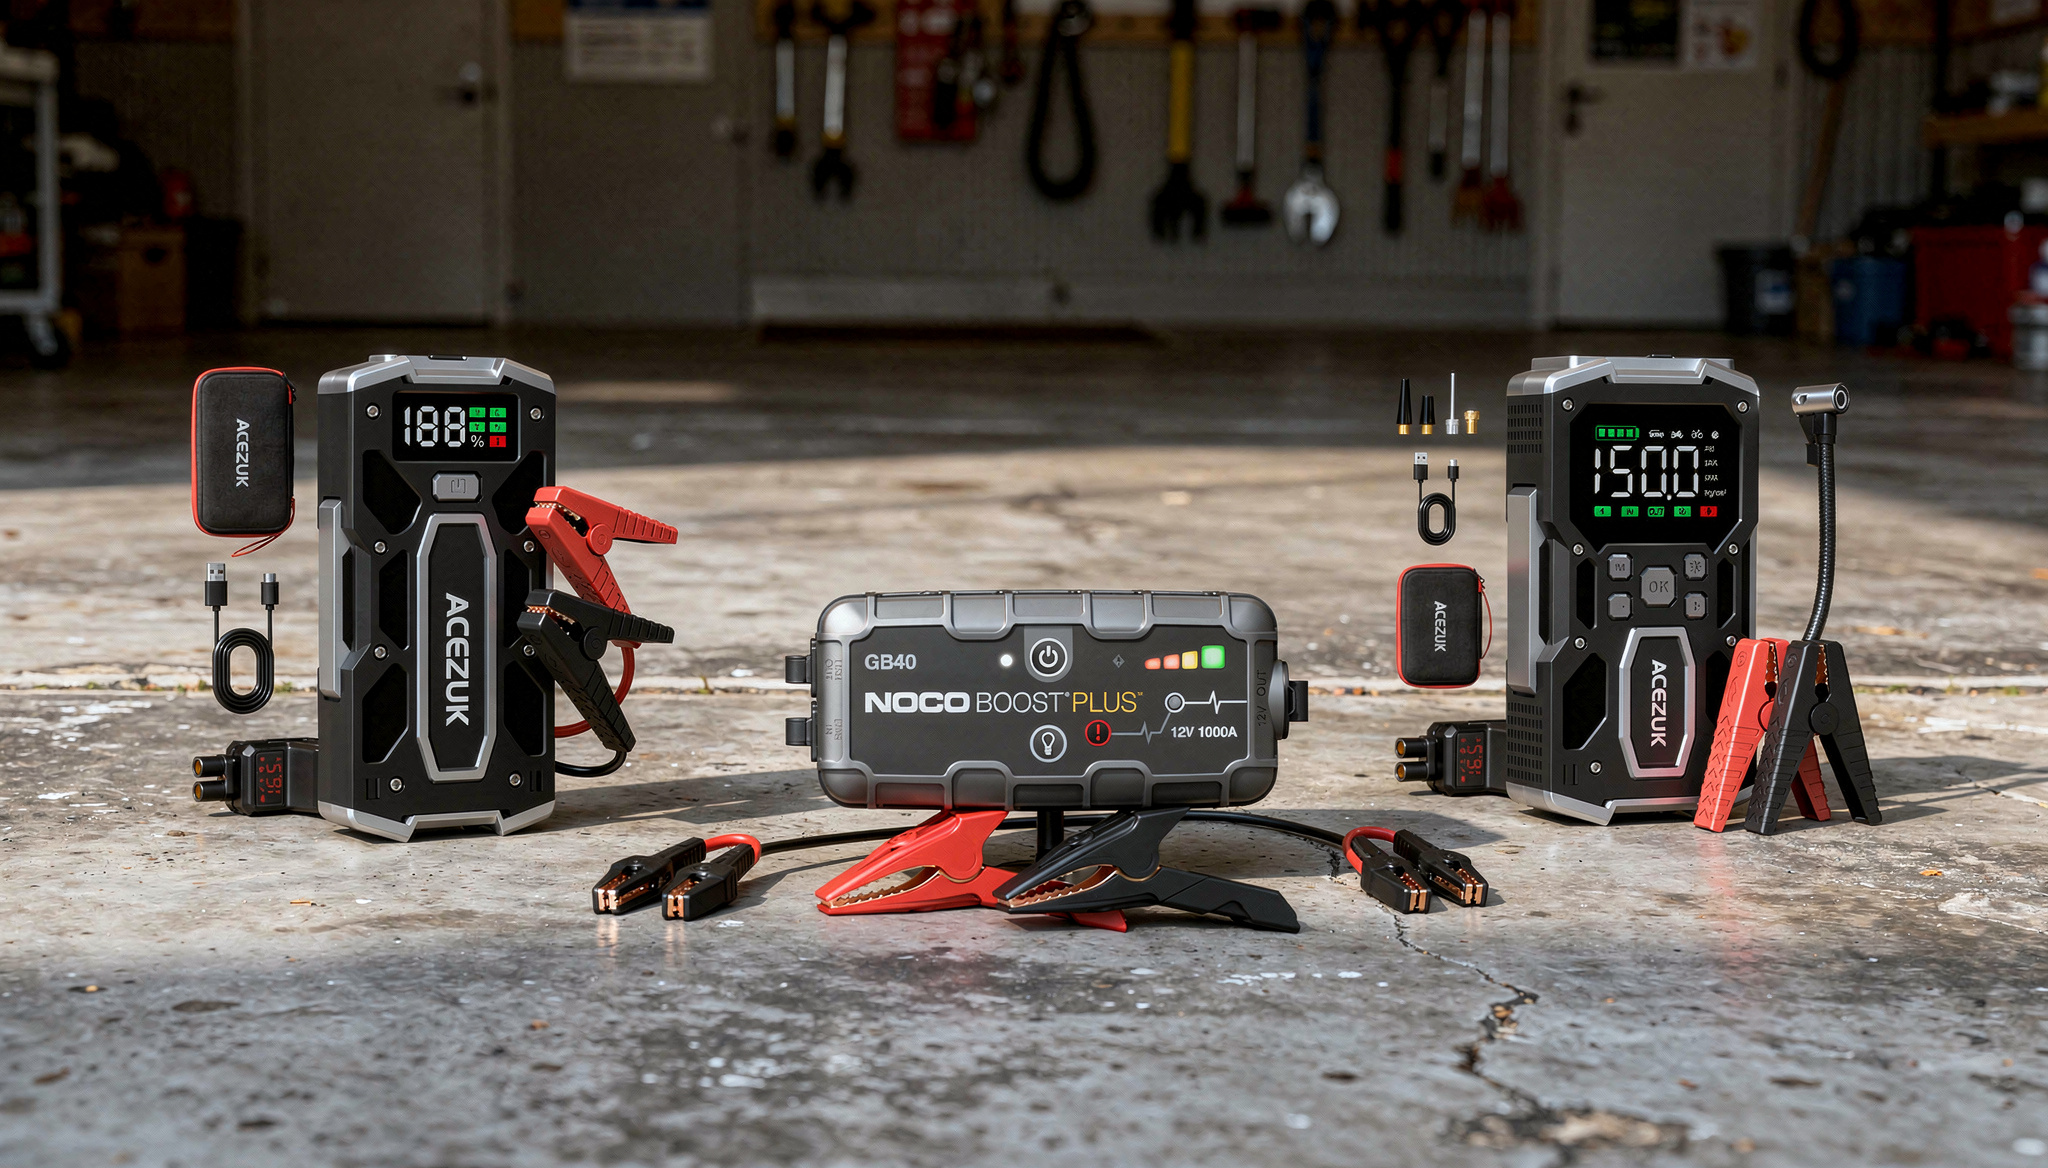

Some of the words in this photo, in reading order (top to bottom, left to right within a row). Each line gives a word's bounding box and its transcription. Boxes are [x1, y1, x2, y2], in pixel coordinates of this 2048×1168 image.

[235, 418, 250, 488] ACEZUK
[1594, 445, 1700, 501] 150.0
[1648, 580, 1669, 593] OK
[1433, 600, 1447, 652] ACEZUK
[445, 592, 471, 727] ACEZUK
[864, 653, 918, 671] GB40
[1256, 669, 1267, 697] OUT
[864, 691, 971, 714] NOCO
[1256, 705, 1267, 727] 12V
[1650, 659, 1668, 748] ACEZUK
[1170, 726, 1194, 738] 12V
[1197, 726, 1239, 738] 1000A
